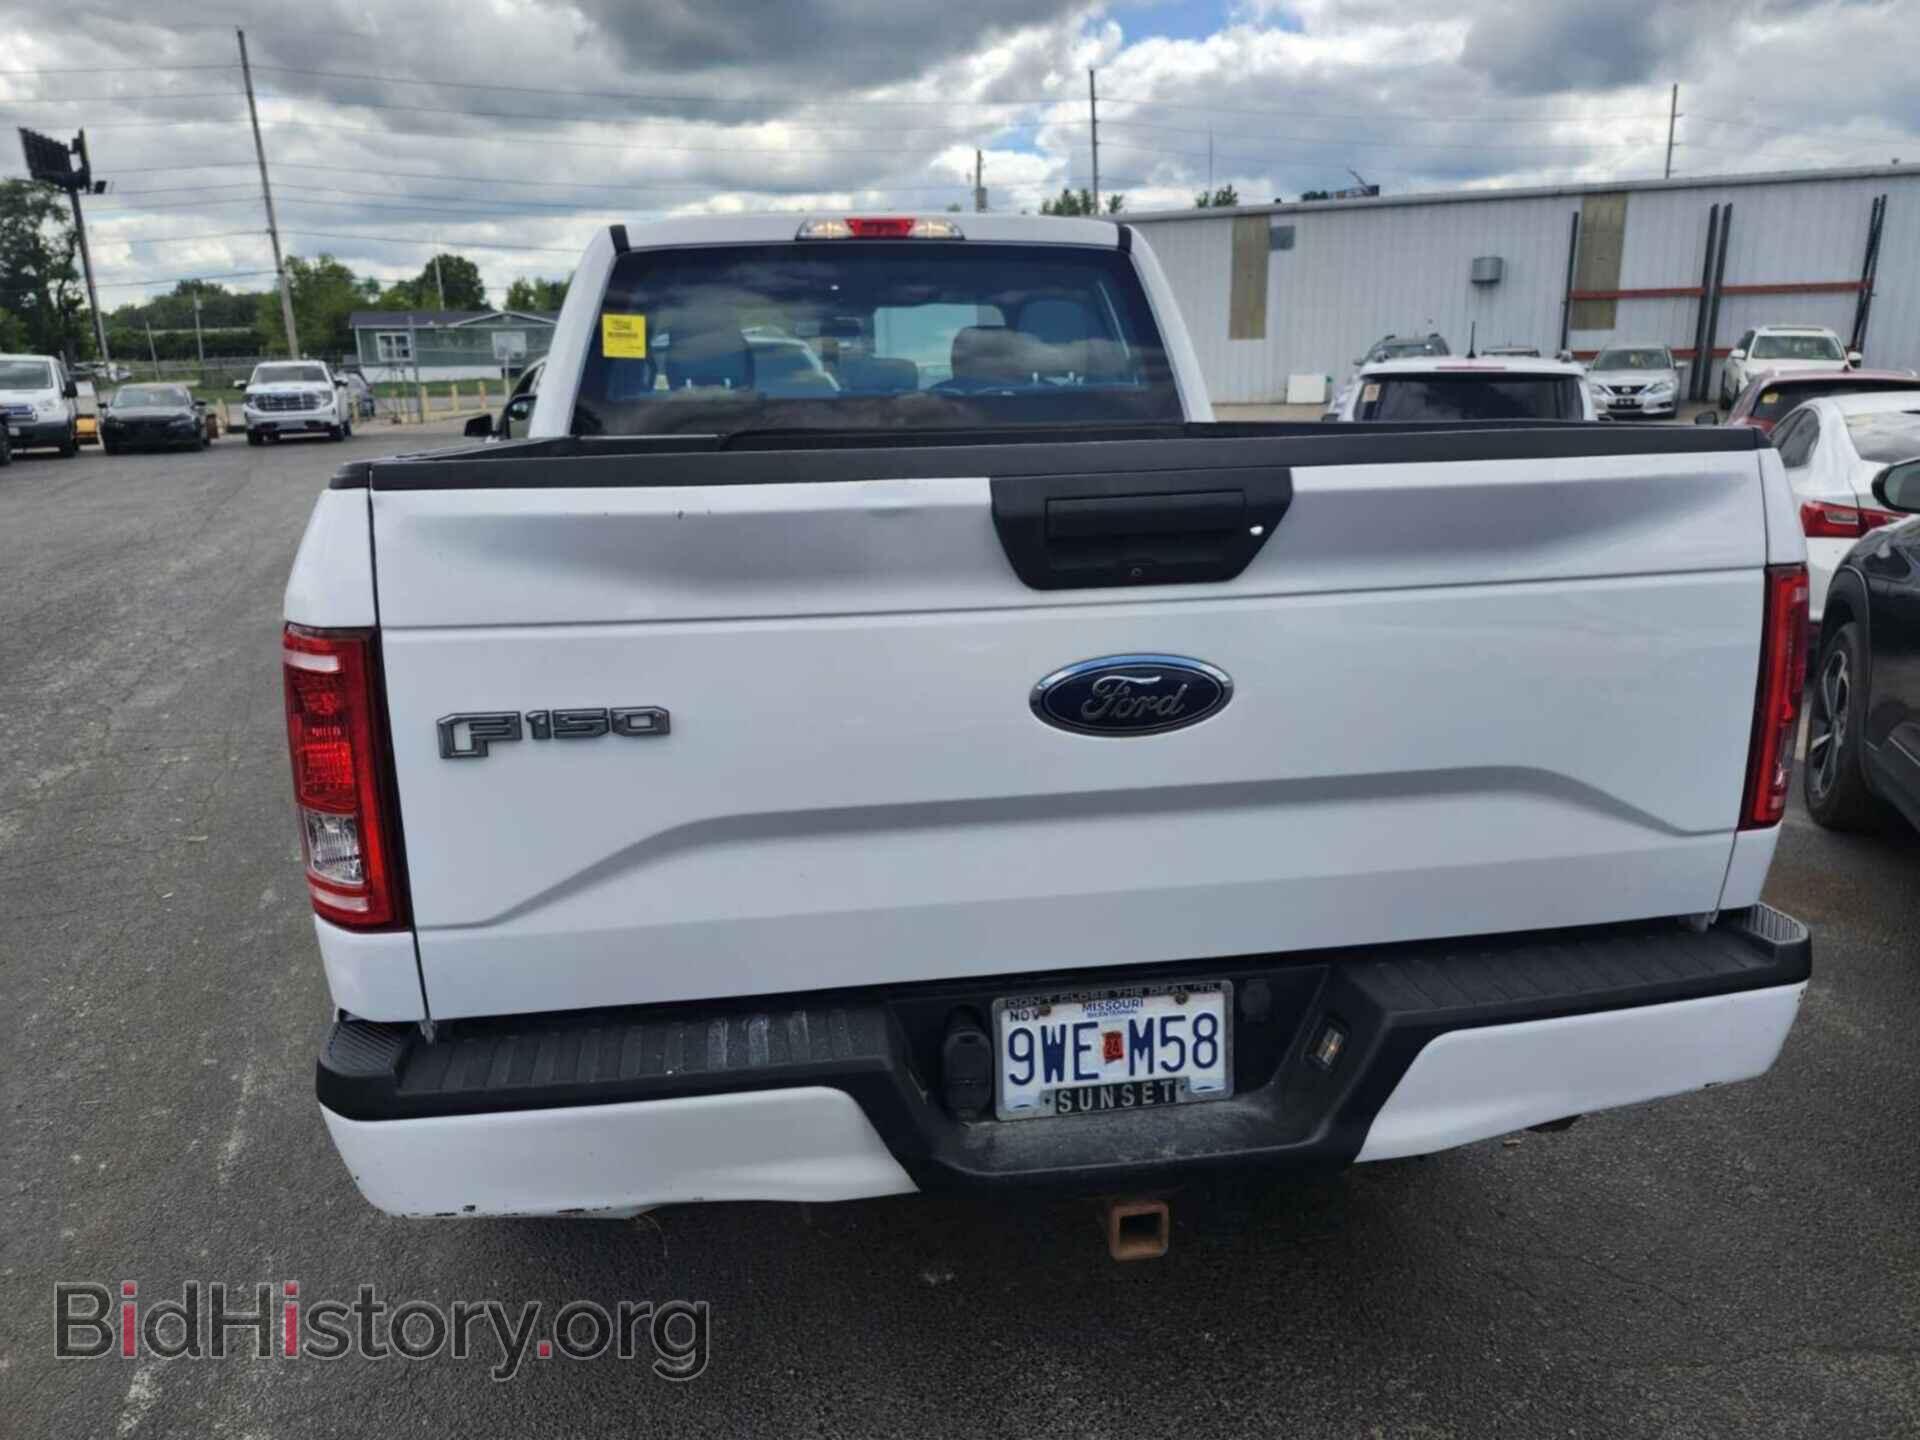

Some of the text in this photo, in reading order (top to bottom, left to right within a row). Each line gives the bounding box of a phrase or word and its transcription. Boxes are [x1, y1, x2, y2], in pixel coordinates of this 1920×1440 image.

[1081, 675, 1188, 719] Ford
[1009, 1008, 1041, 1022] NOV
[1082, 998, 1144, 1013] MISSOURI
[1008, 1012, 1218, 1086] 9WE M58
[1058, 1081, 1174, 1113] SUNSET
